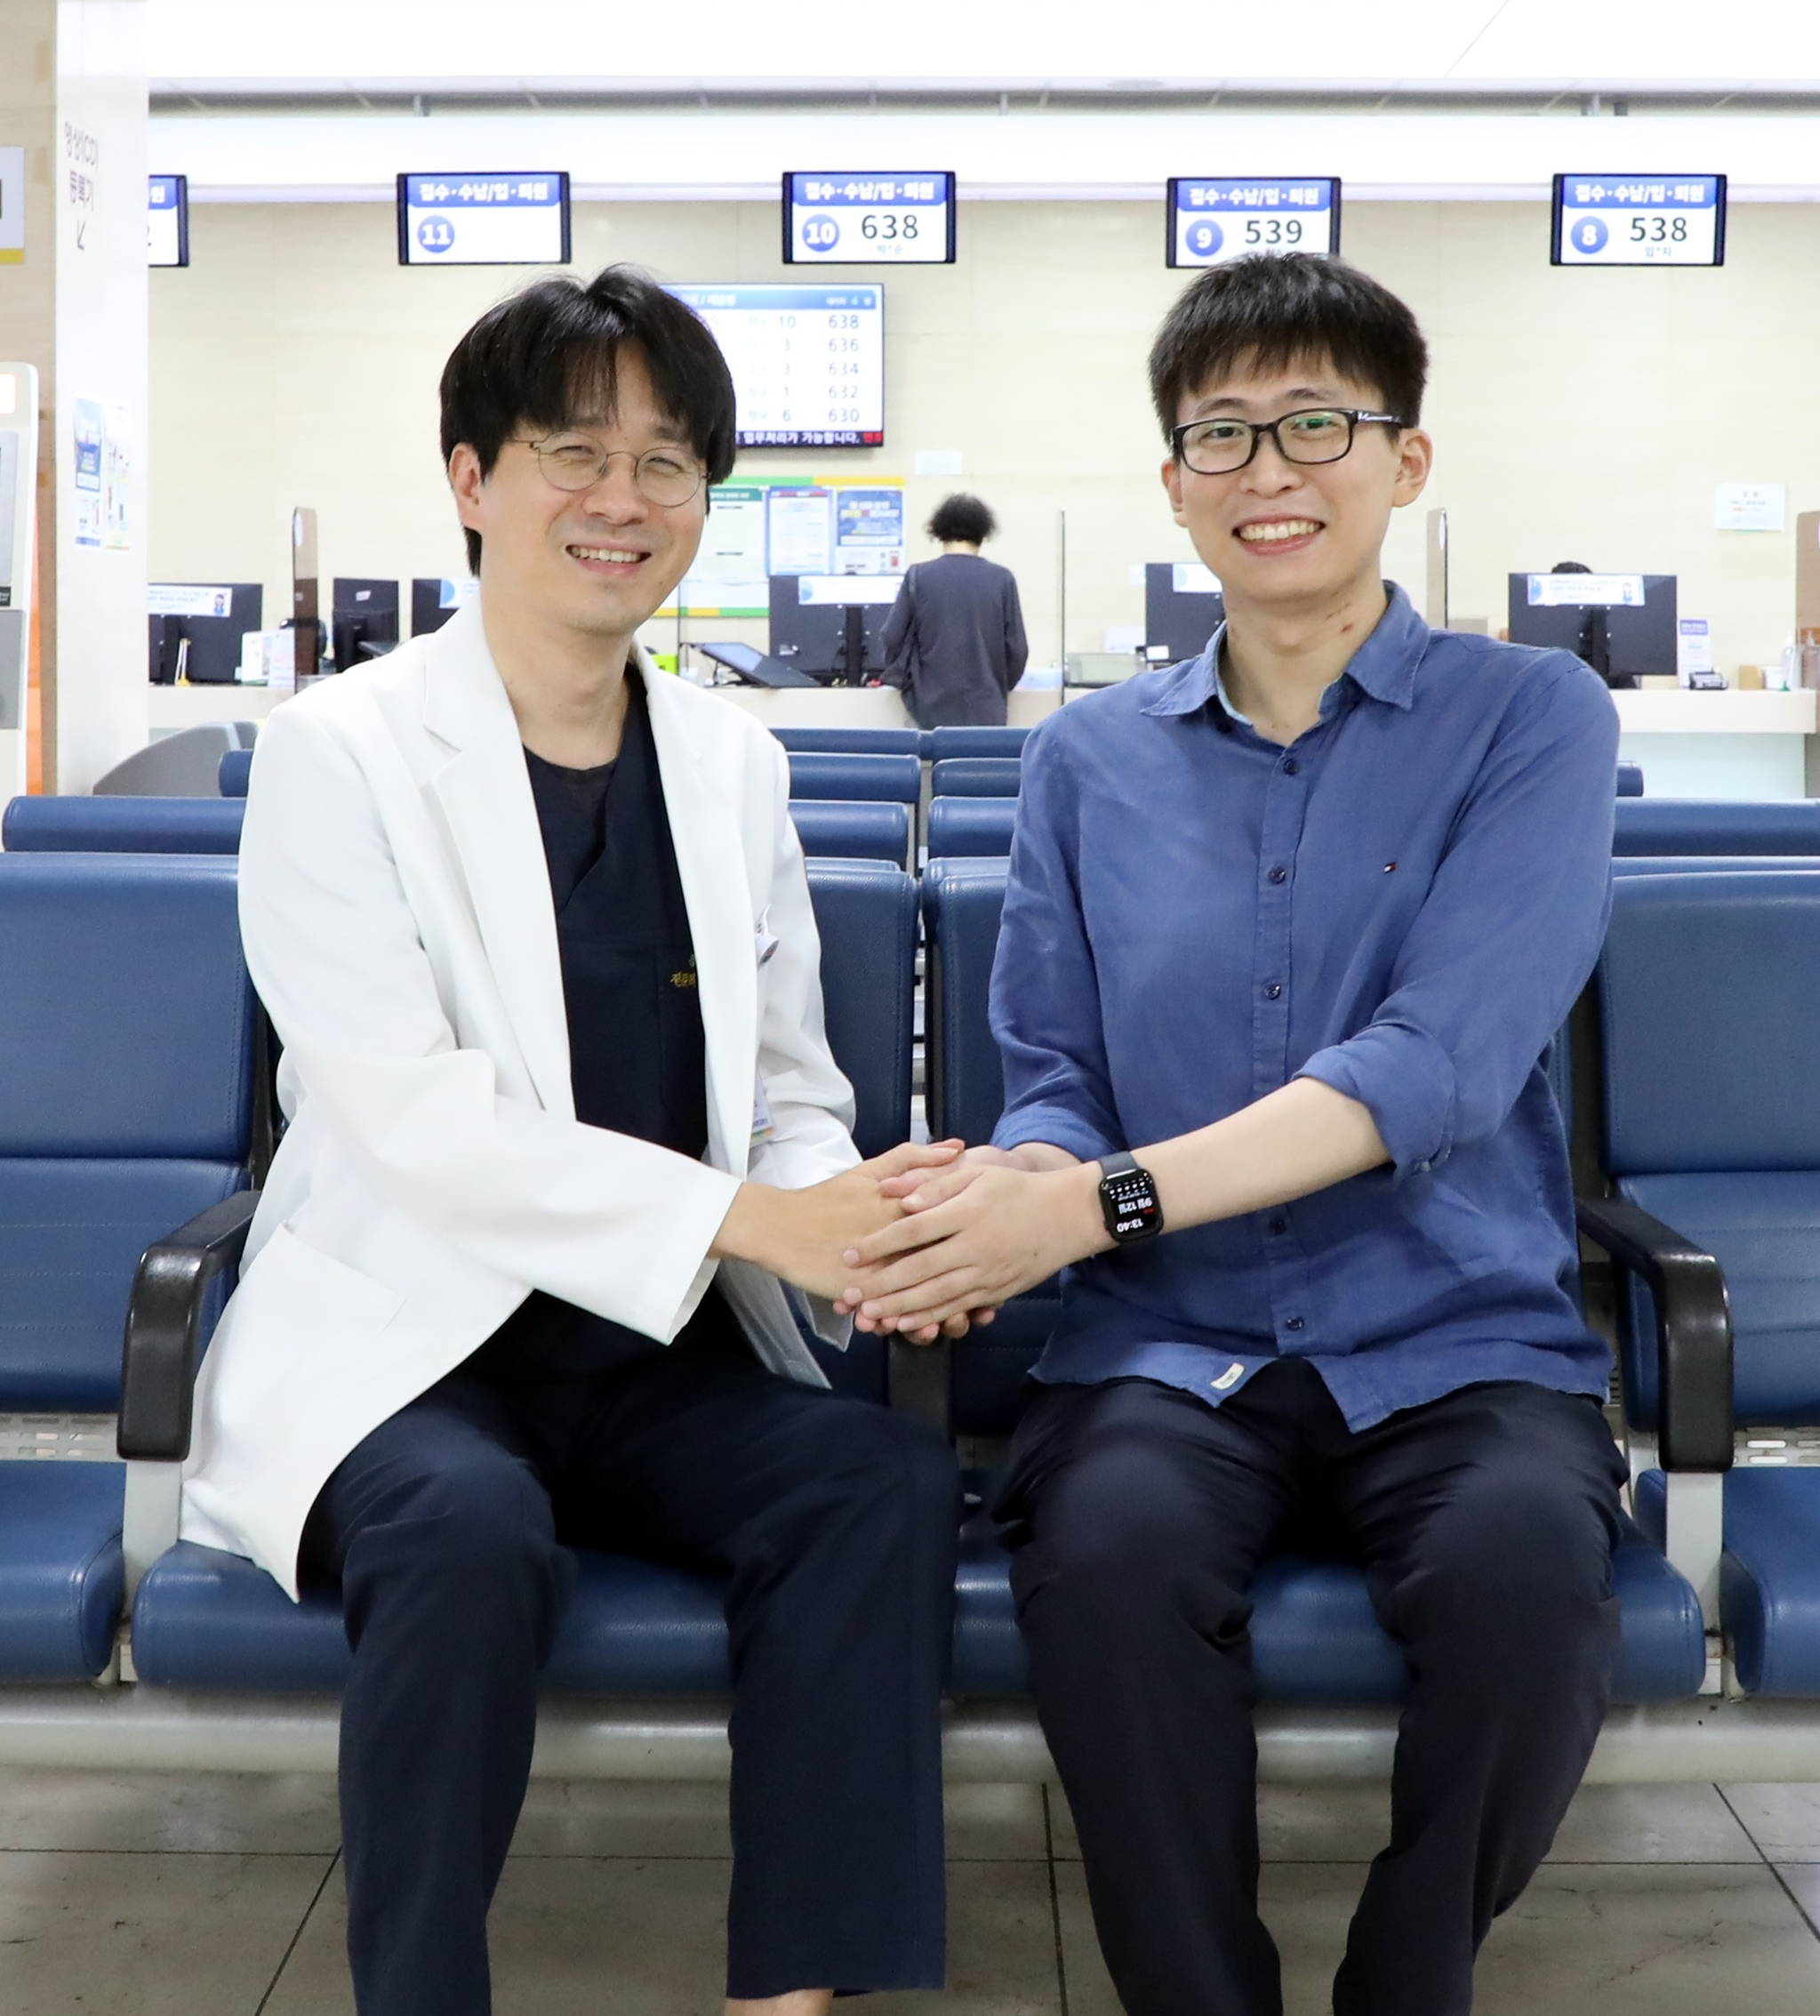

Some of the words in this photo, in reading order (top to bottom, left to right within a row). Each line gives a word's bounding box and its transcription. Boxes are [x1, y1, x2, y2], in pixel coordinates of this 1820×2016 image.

[421, 223, 451, 245] 11
[806, 221, 837, 245] 10
[861, 214, 918, 239] 638
[1245, 219, 1303, 245] 539
[1581, 223, 1598, 246] 8
[1630, 216, 1688, 242] 538
[1196, 227, 1213, 249] 9
[779, 315, 797, 328] 10
[828, 314, 860, 329] 638
[784, 339, 790, 352] 3
[828, 338, 860, 352] 636
[784, 363, 790, 375] 3
[828, 362, 860, 376] 634
[783, 386, 790, 398] 1
[828, 385, 859, 398] 632
[782, 408, 791, 422] 6
[828, 408, 860, 422] 630
[743, 431, 798, 445] 업무처리가
[802, 431, 860, 445] 가능합니다.
